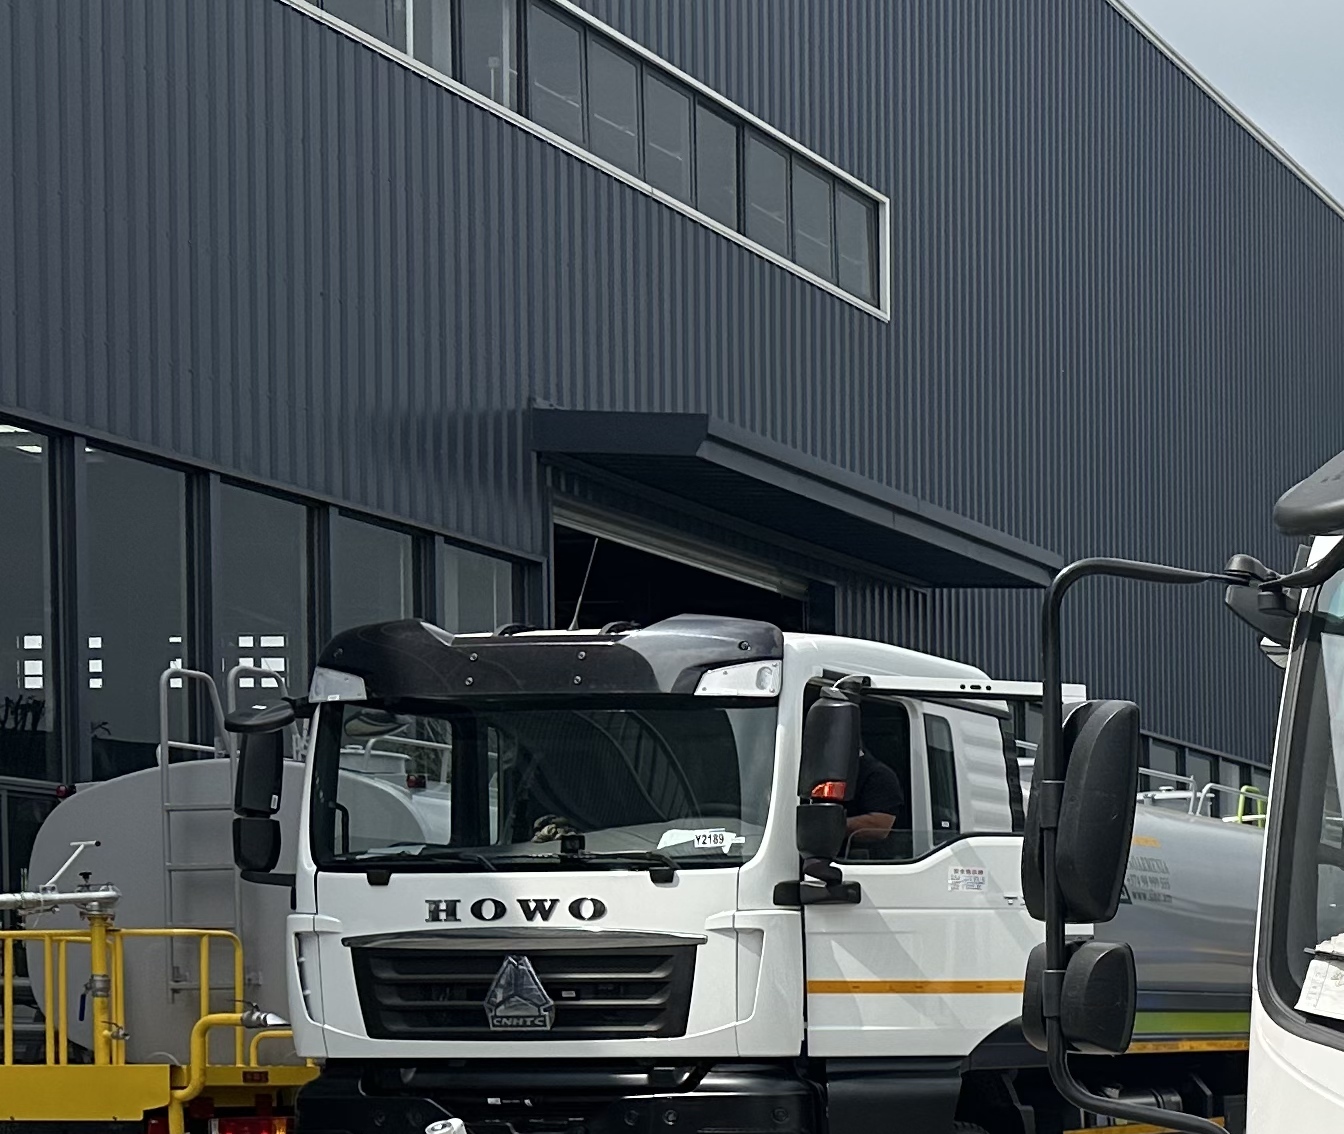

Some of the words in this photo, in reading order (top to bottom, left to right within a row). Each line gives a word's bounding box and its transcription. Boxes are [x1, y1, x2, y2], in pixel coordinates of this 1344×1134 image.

[695, 834, 724, 845] Y2189
[425, 897, 607, 922] HOWO
[493, 1017, 545, 1026] CNHTC
